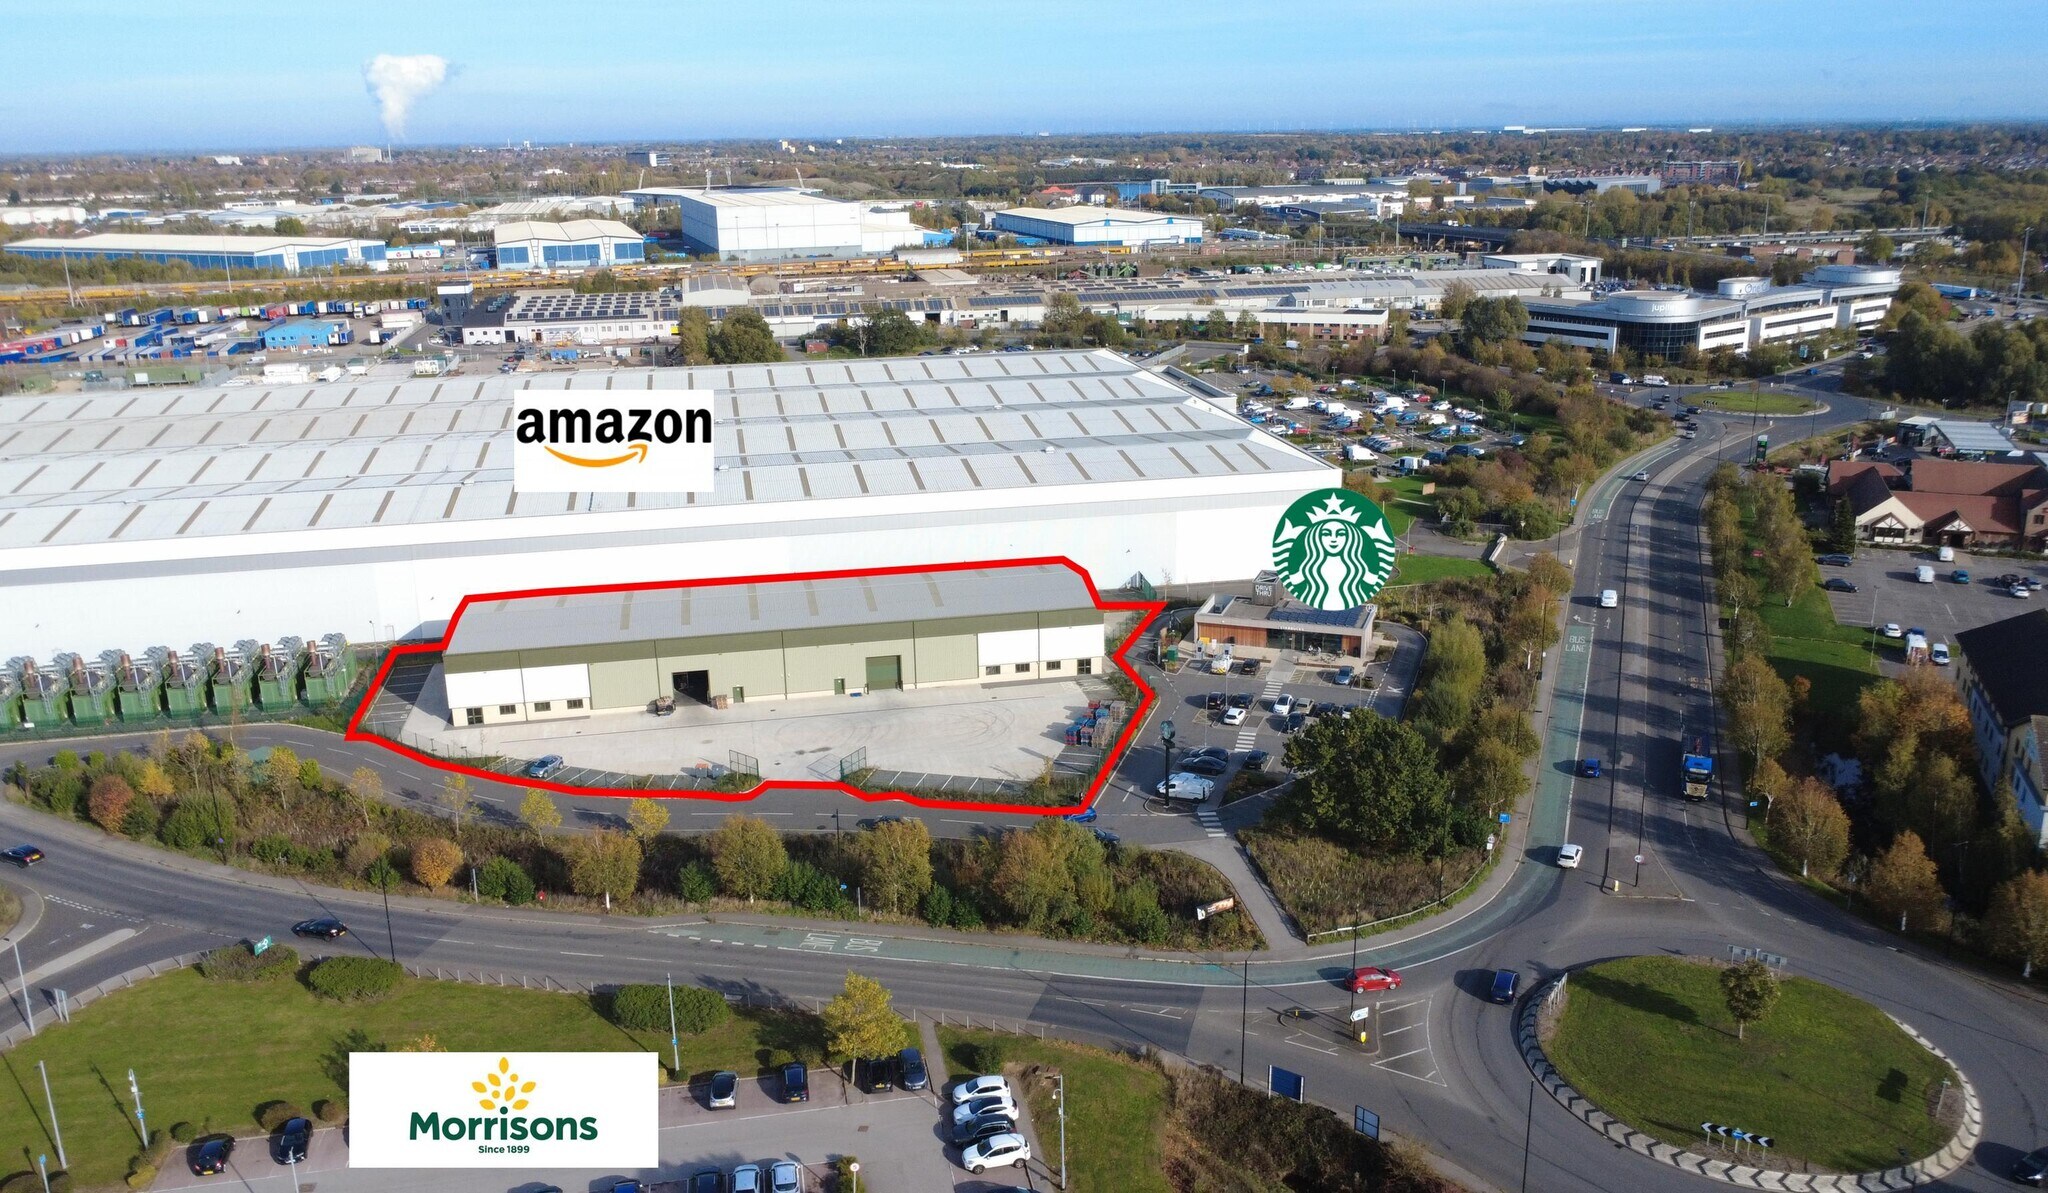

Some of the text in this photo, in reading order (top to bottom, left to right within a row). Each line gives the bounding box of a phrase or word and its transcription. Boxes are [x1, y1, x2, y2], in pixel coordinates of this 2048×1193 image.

[1569, 635, 1585, 644] BUS
[1565, 644, 1586, 652] LANE
[799, 933, 840, 951] LANE
[844, 938, 883, 952] BUS
